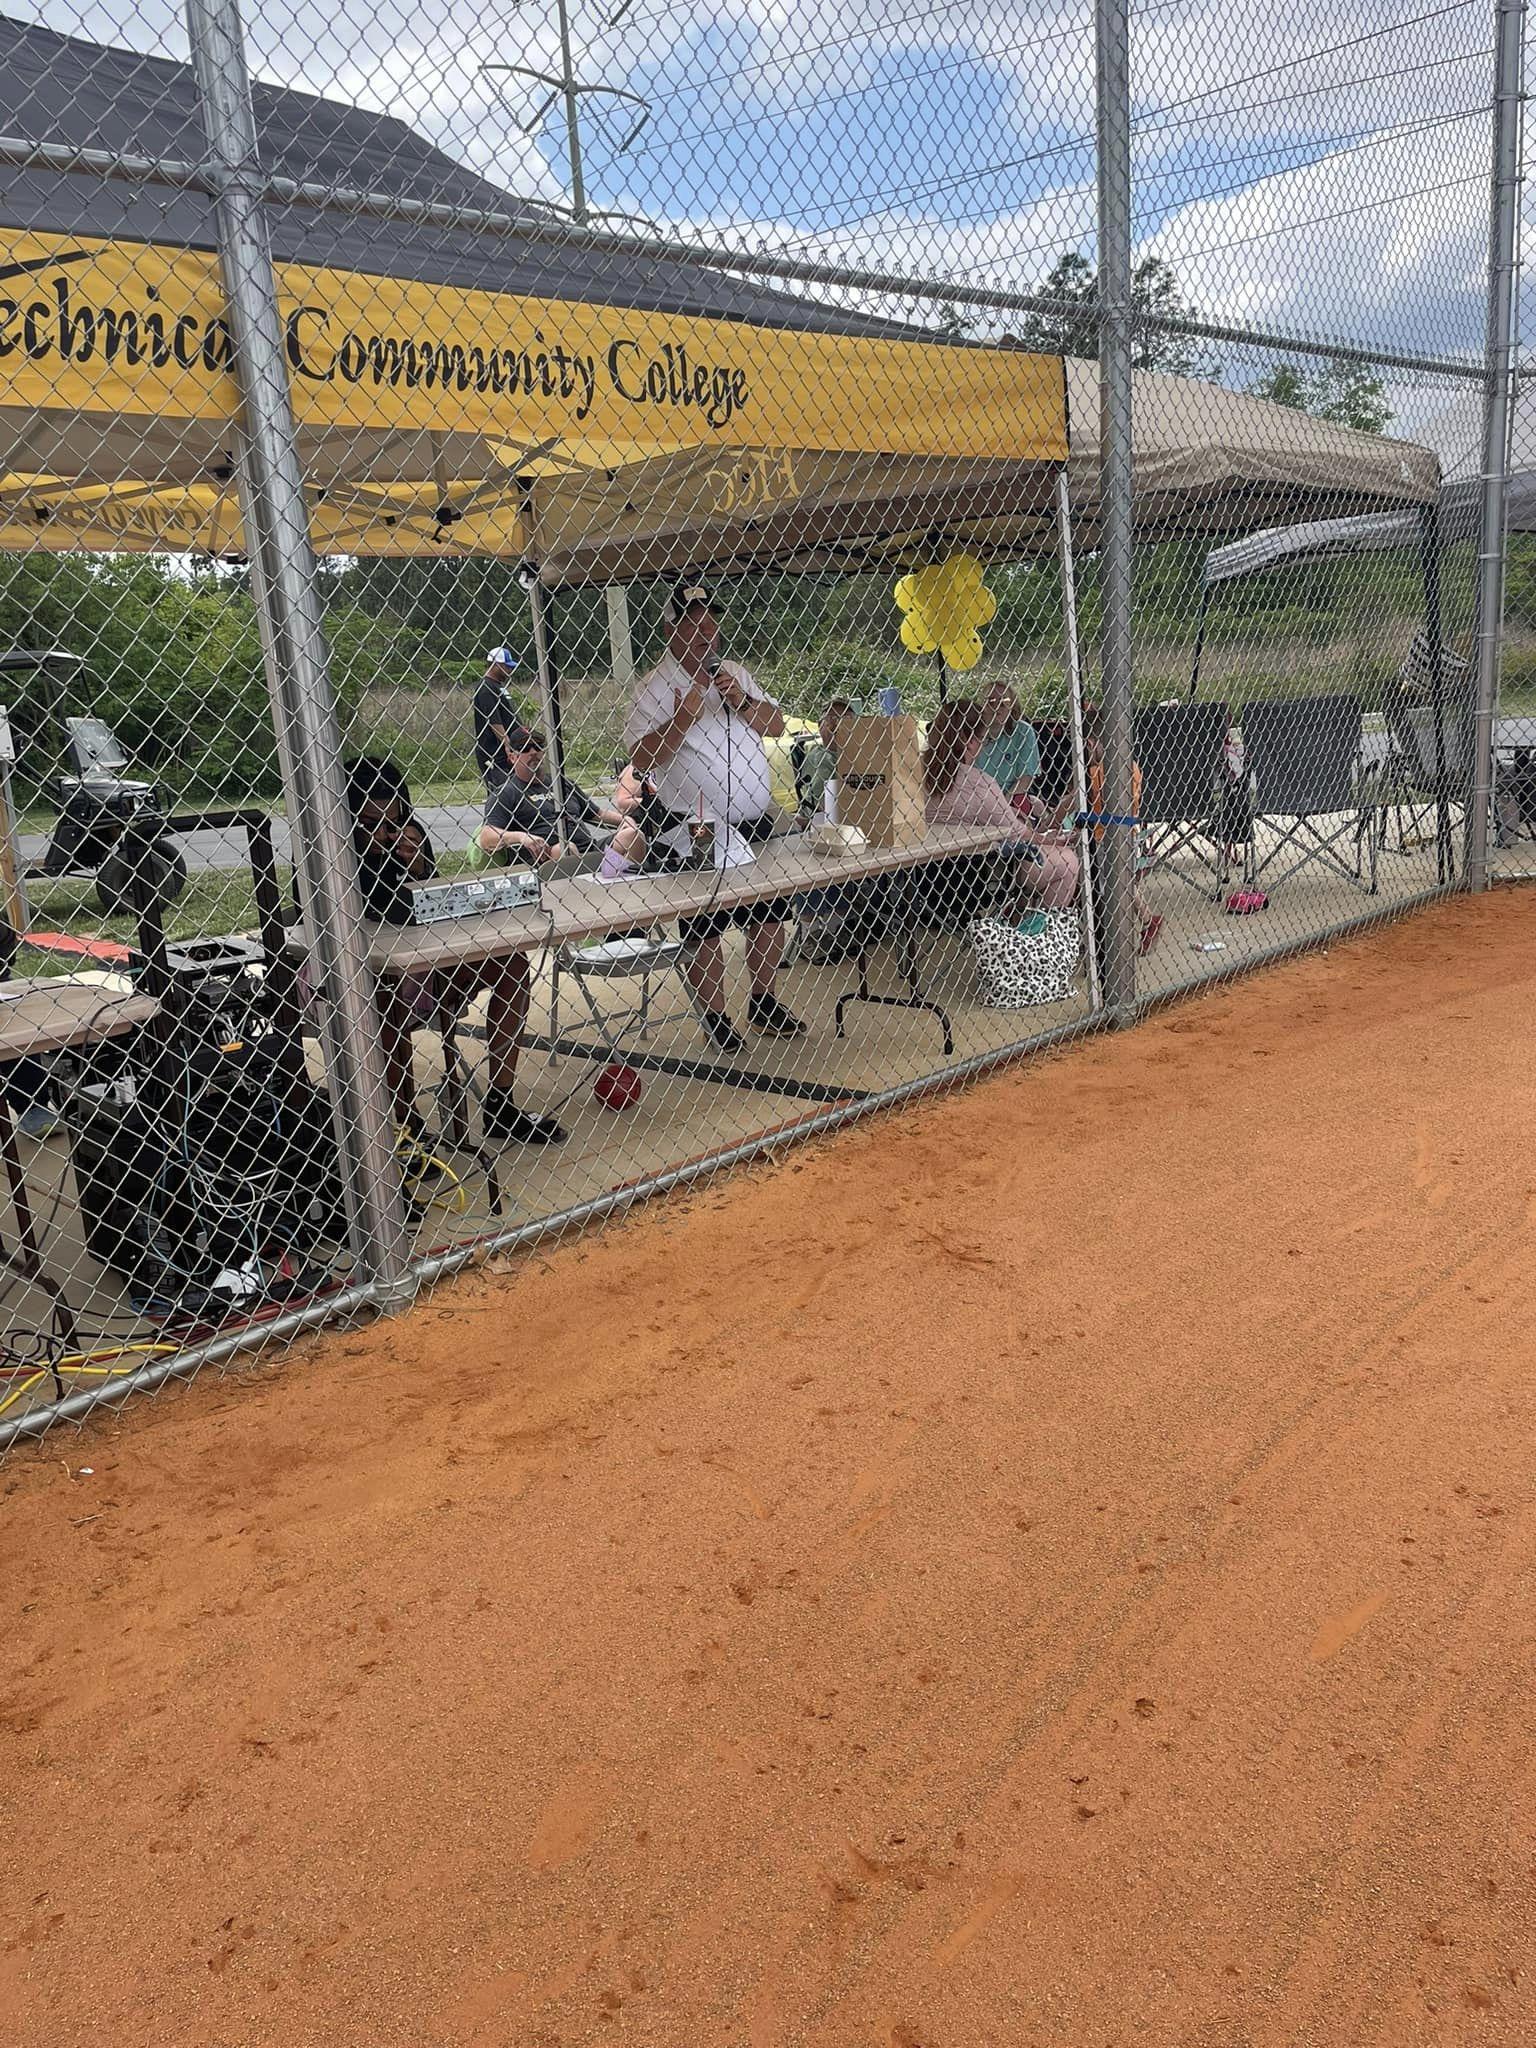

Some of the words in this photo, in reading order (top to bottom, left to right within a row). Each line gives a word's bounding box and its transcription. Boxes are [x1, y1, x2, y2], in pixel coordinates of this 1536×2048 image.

[0, 277, 236, 373] echnica
[286, 306, 594, 420] Community
[608, 339, 749, 429] College
